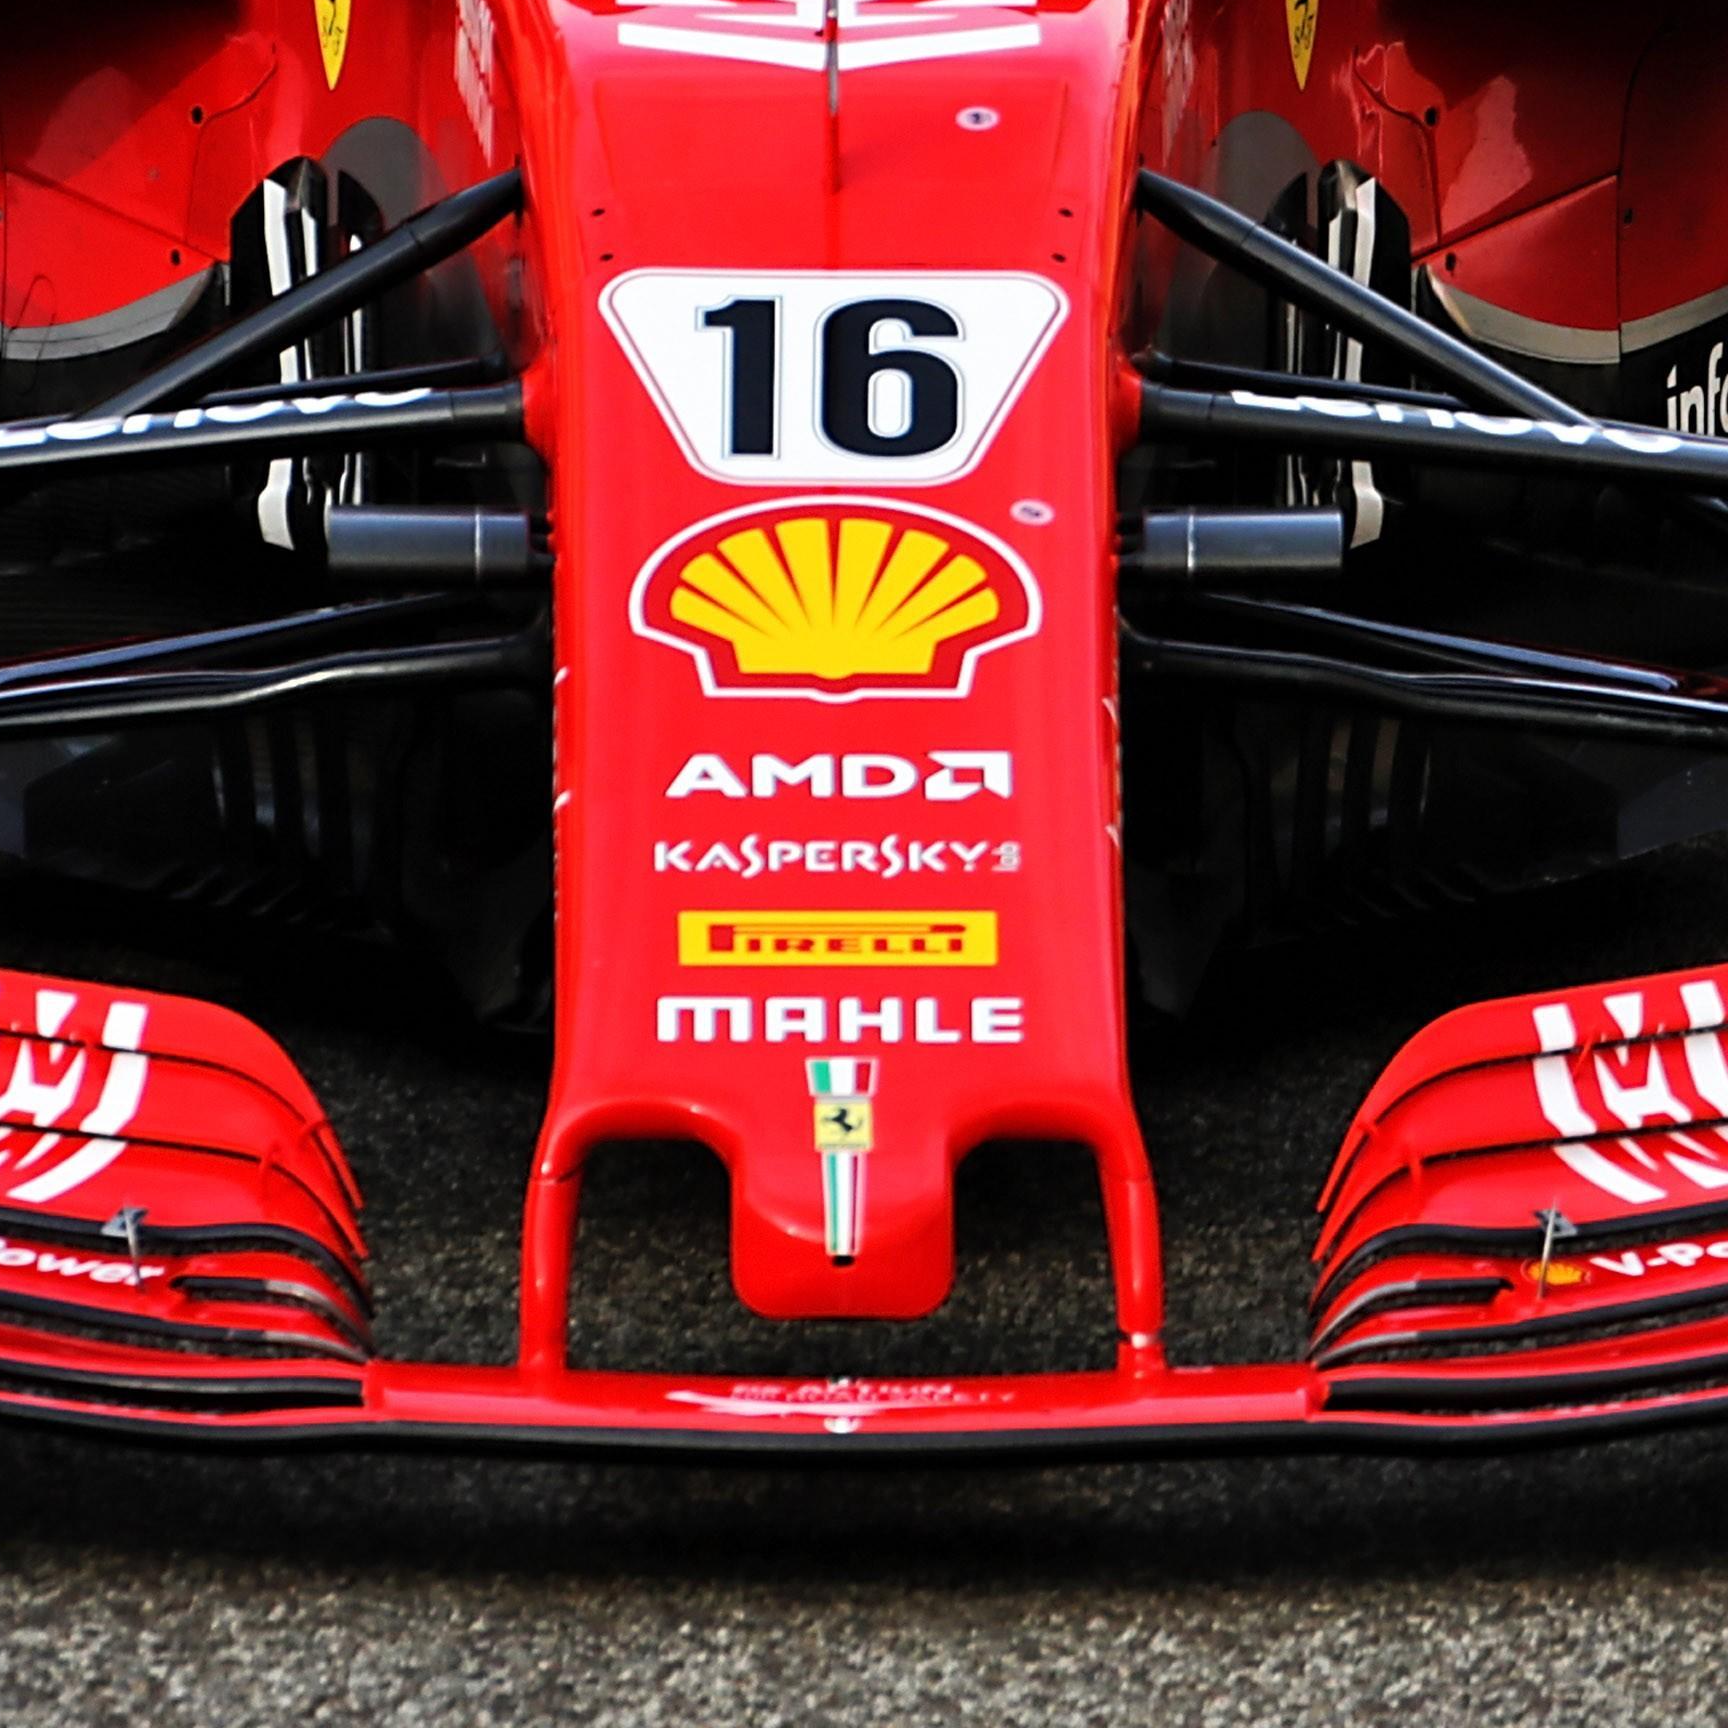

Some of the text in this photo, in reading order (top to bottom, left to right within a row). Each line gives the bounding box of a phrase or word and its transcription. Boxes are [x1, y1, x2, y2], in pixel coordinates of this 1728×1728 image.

[702, 297, 961, 458] 16
[665, 753, 918, 798] AMD
[653, 834, 989, 878] KASPERSKY
[708, 923, 966, 953] PIRELLI
[656, 996, 1024, 1043] MAHLE
